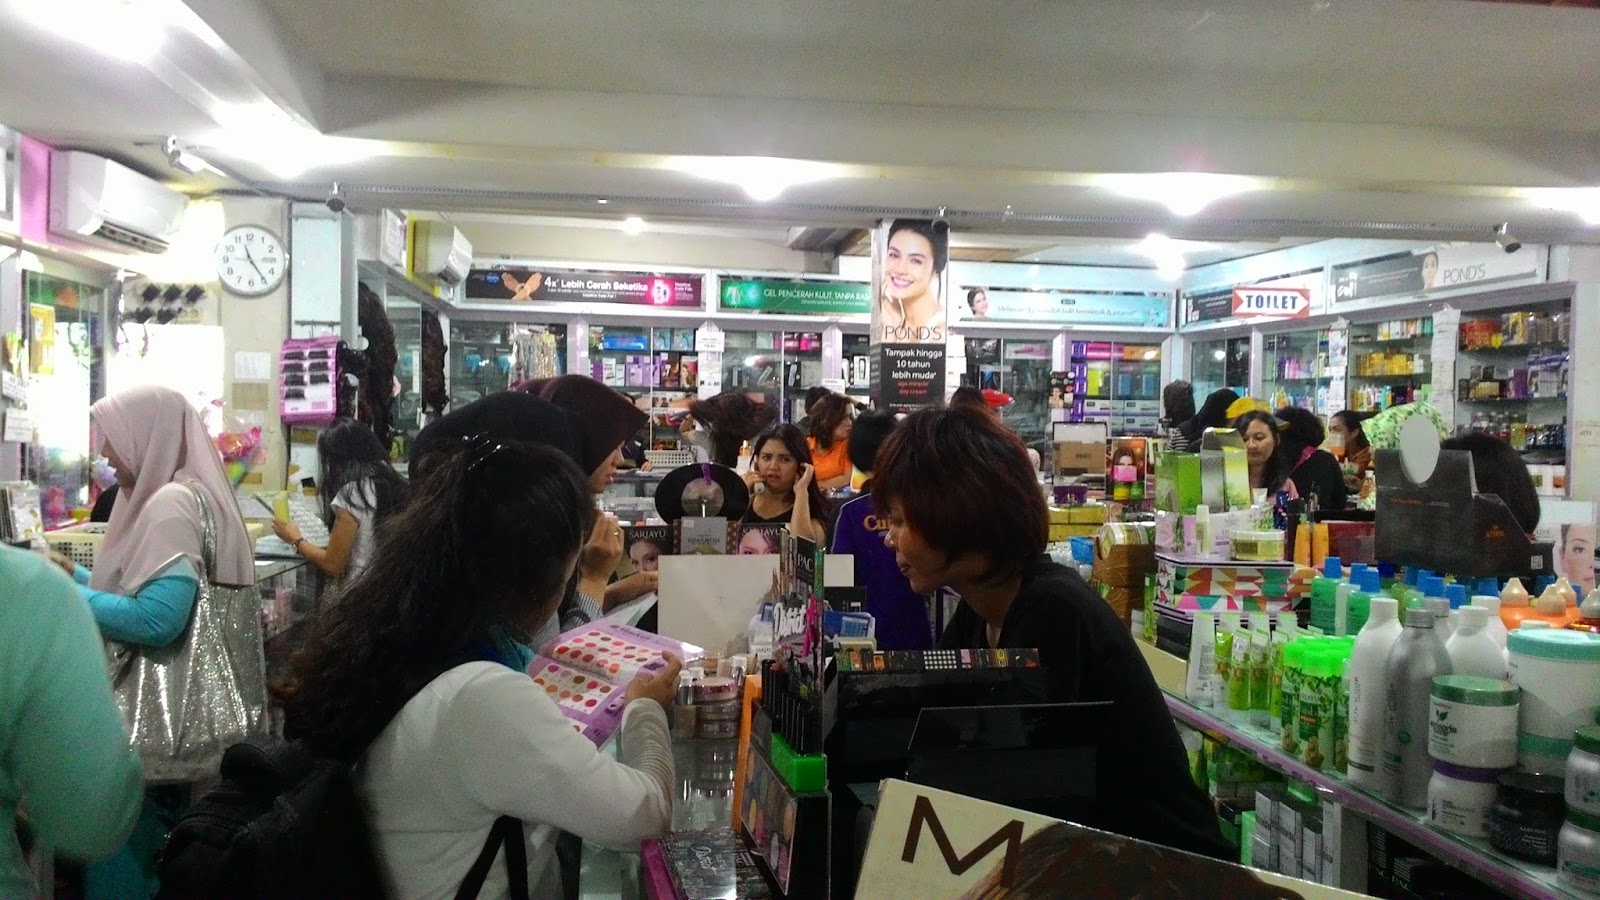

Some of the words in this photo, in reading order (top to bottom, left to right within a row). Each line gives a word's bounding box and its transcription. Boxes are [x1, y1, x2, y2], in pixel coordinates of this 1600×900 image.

[234, 236, 242, 244] 11
[246, 233, 254, 241] 12
[226, 244, 234, 252] 10
[268, 244, 274, 253] 2
[227, 266, 234, 275] 8
[268, 267, 275, 275] 4
[1443, 264, 1486, 284] POND'S
[236, 275, 242, 284] 7
[561, 279, 585, 290] Lebih
[764, 289, 776, 297] GEL
[778, 290, 814, 298] PENCERAH
[834, 292, 855, 300] TANPA
[1246, 294, 1298, 310] TOILET
[885, 325, 942, 340] POND'S
[884, 348, 916, 358] Tampak
[916, 349, 942, 359] hingga
[896, 360, 906, 368] 10
[908, 360, 930, 368] tahun
[892, 371, 912, 380] lebih
[798, 553, 814, 572] PAC
[902, 795, 1024, 888] M
